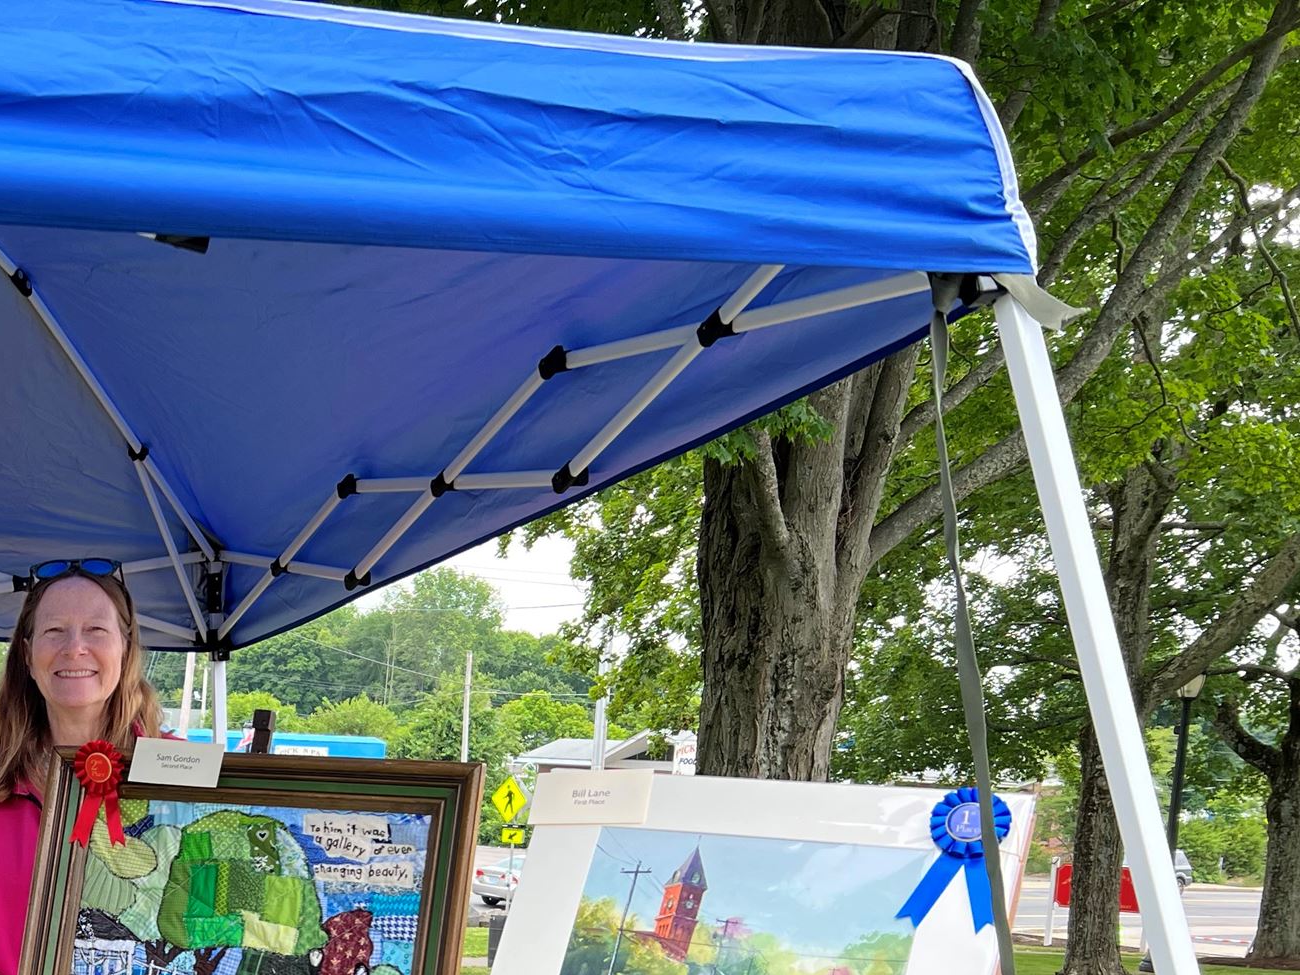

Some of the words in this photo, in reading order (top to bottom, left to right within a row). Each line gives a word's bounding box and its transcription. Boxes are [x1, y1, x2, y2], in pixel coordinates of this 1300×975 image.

[156, 753, 172, 762] Sam
[173, 754, 201, 764] Gordon
[161, 762, 180, 770] Second
[572, 789, 586, 798] Bill
[588, 789, 611, 798] Lane
[310, 824, 320, 833] To
[323, 821, 343, 834] him
[346, 823, 357, 835] it
[362, 828, 386, 837] was
[315, 835, 323, 843] a
[325, 836, 366, 858] gallery
[373, 845, 385, 856] of
[387, 845, 413, 855] ever
[314, 865, 363, 880] changing
[368, 864, 408, 880] beauty.
